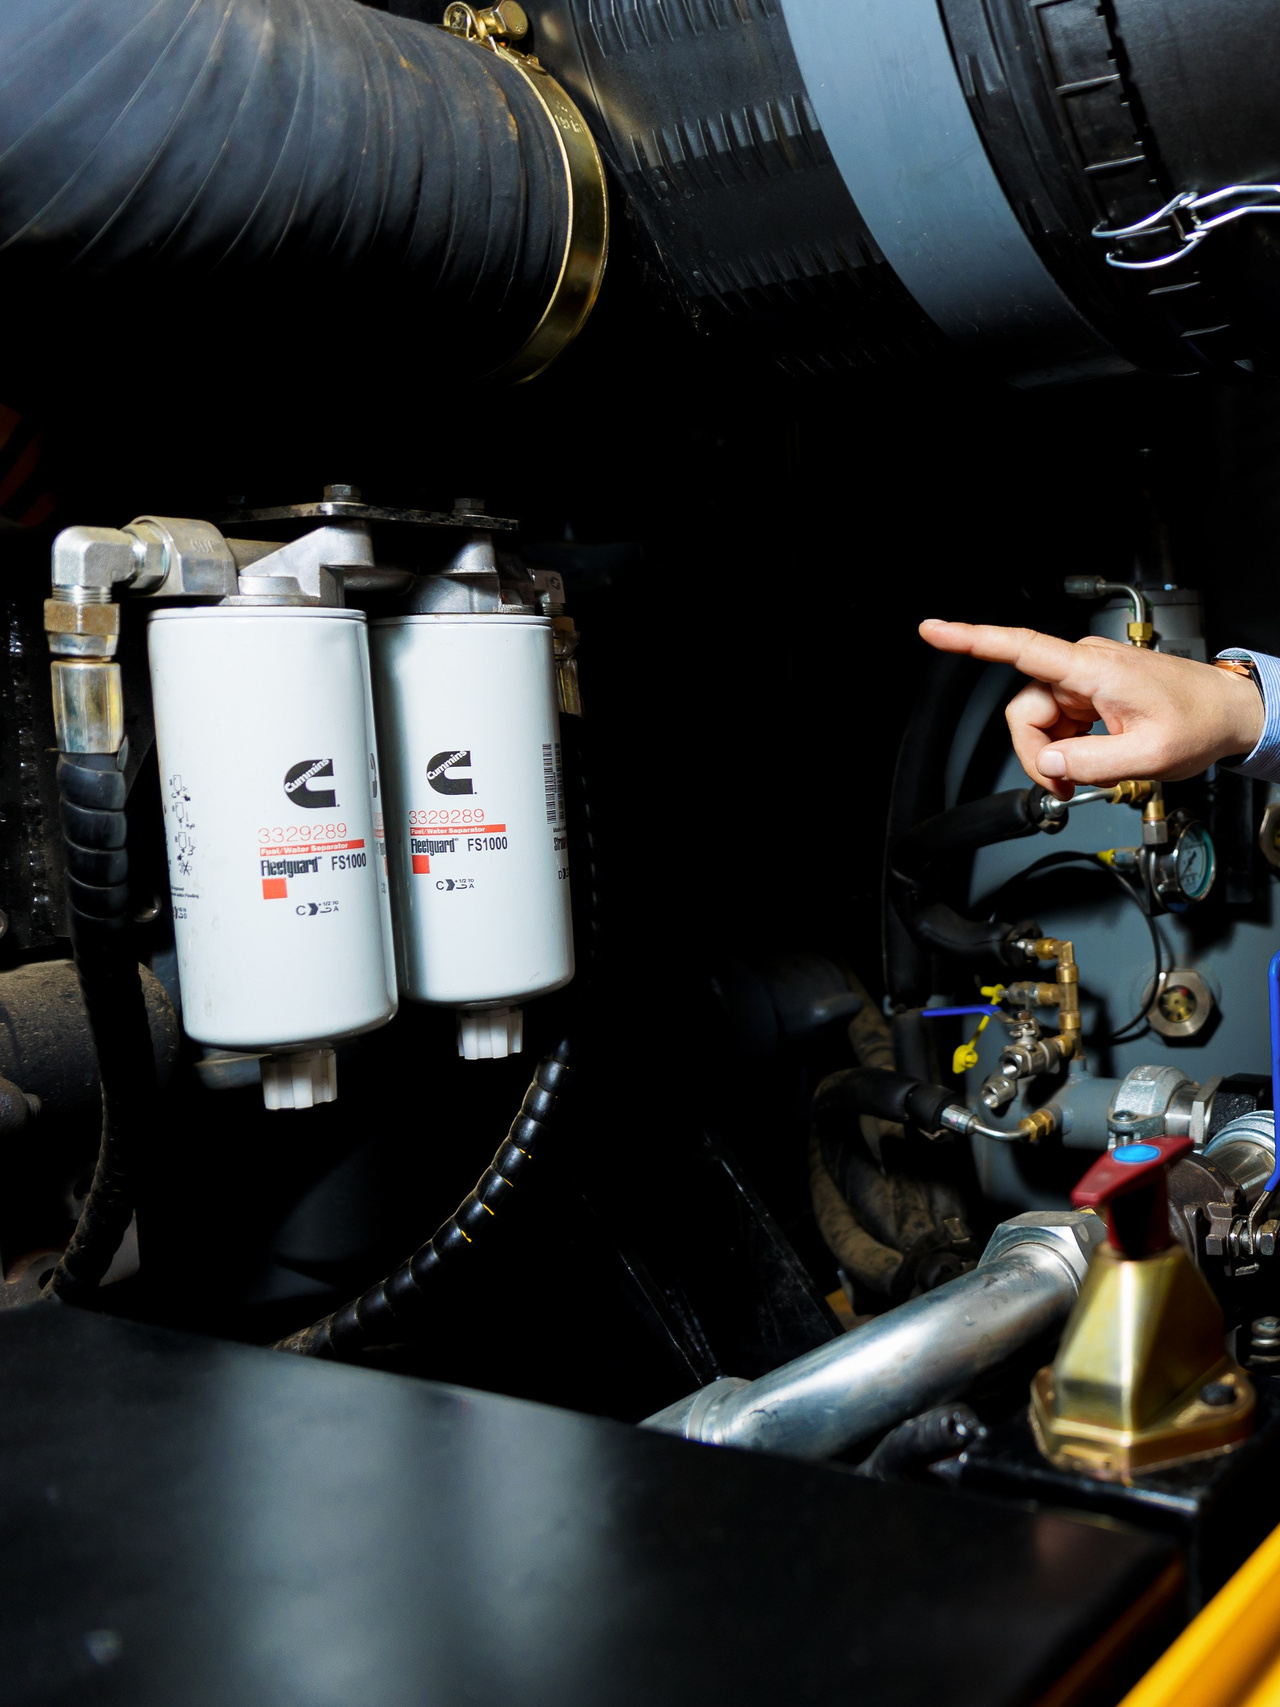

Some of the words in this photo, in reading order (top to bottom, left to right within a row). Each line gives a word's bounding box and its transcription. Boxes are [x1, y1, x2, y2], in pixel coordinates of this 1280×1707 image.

[427, 750, 467, 780] Cummins
[284, 758, 330, 793] Cummins
[408, 808, 484, 825] 3329289
[258, 822, 347, 844] 3329289
[260, 847, 309, 856] Fuel/Water
[310, 843, 348, 854] Separator
[467, 836, 508, 852] FS1000
[331, 852, 367, 871] FS1000
[436, 880, 445, 890] C
[296, 905, 306, 916] C
